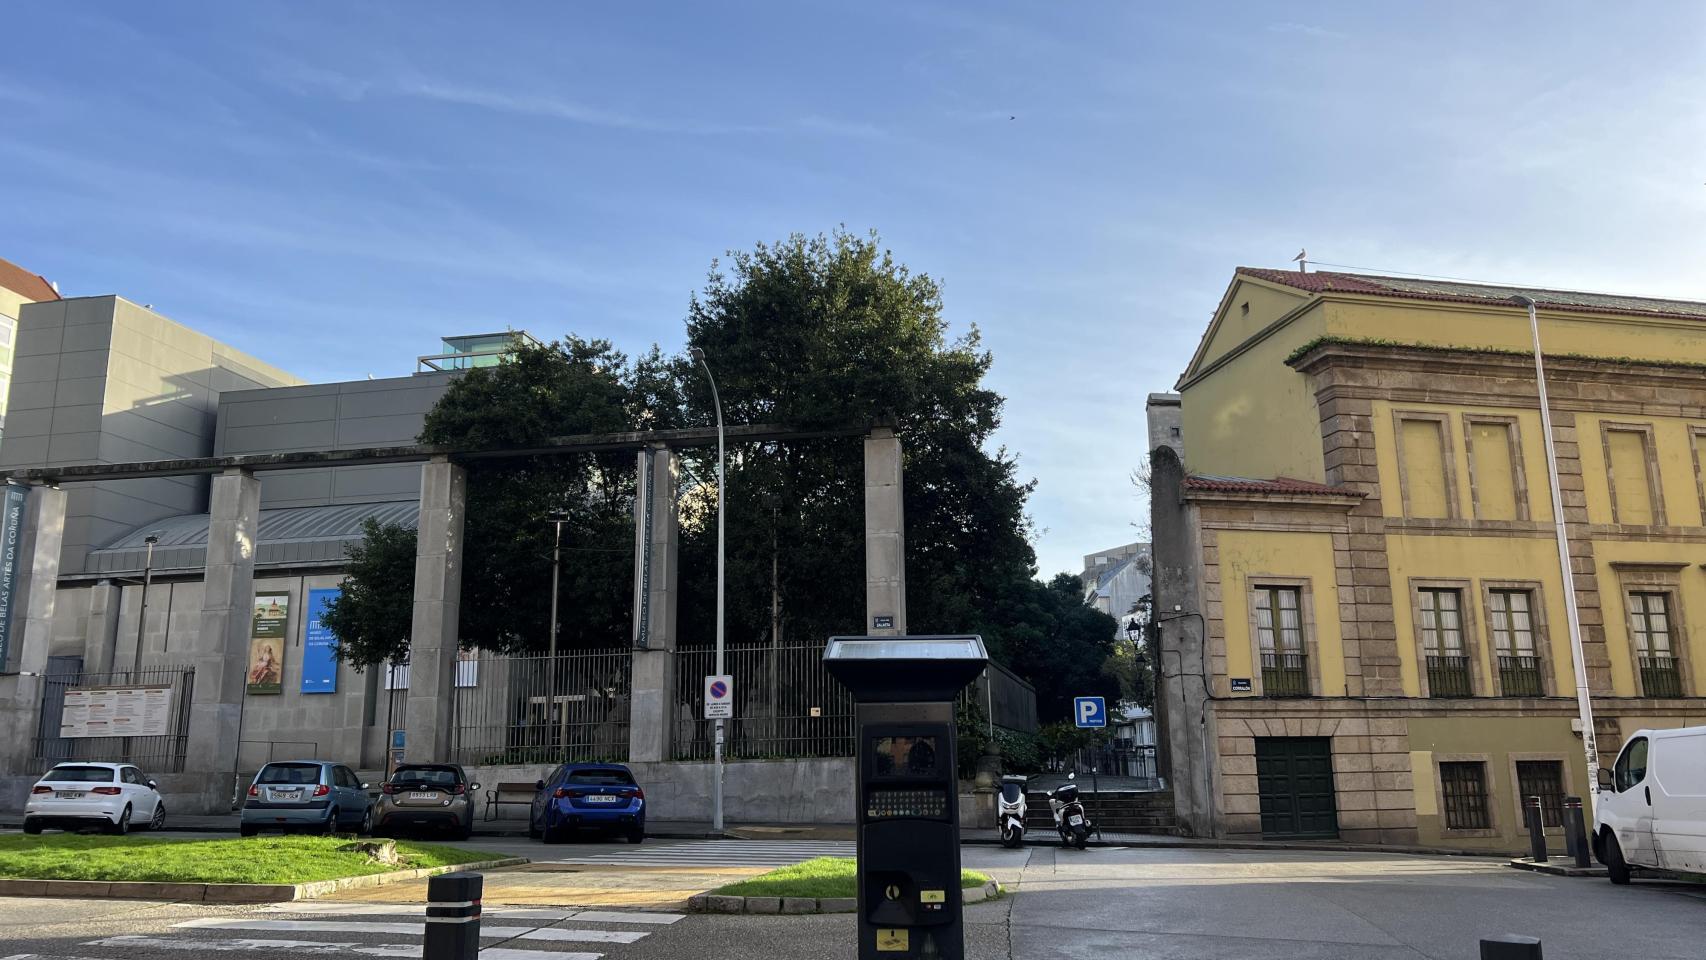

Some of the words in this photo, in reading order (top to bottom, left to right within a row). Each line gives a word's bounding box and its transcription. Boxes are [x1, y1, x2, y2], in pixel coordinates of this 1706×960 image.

[8, 506, 20, 545] CORUÑA
[7, 546, 15, 560] DA
[3, 561, 13, 590] ARTES
[0, 591, 9, 618] BELAS
[1080, 701, 1098, 723] P
